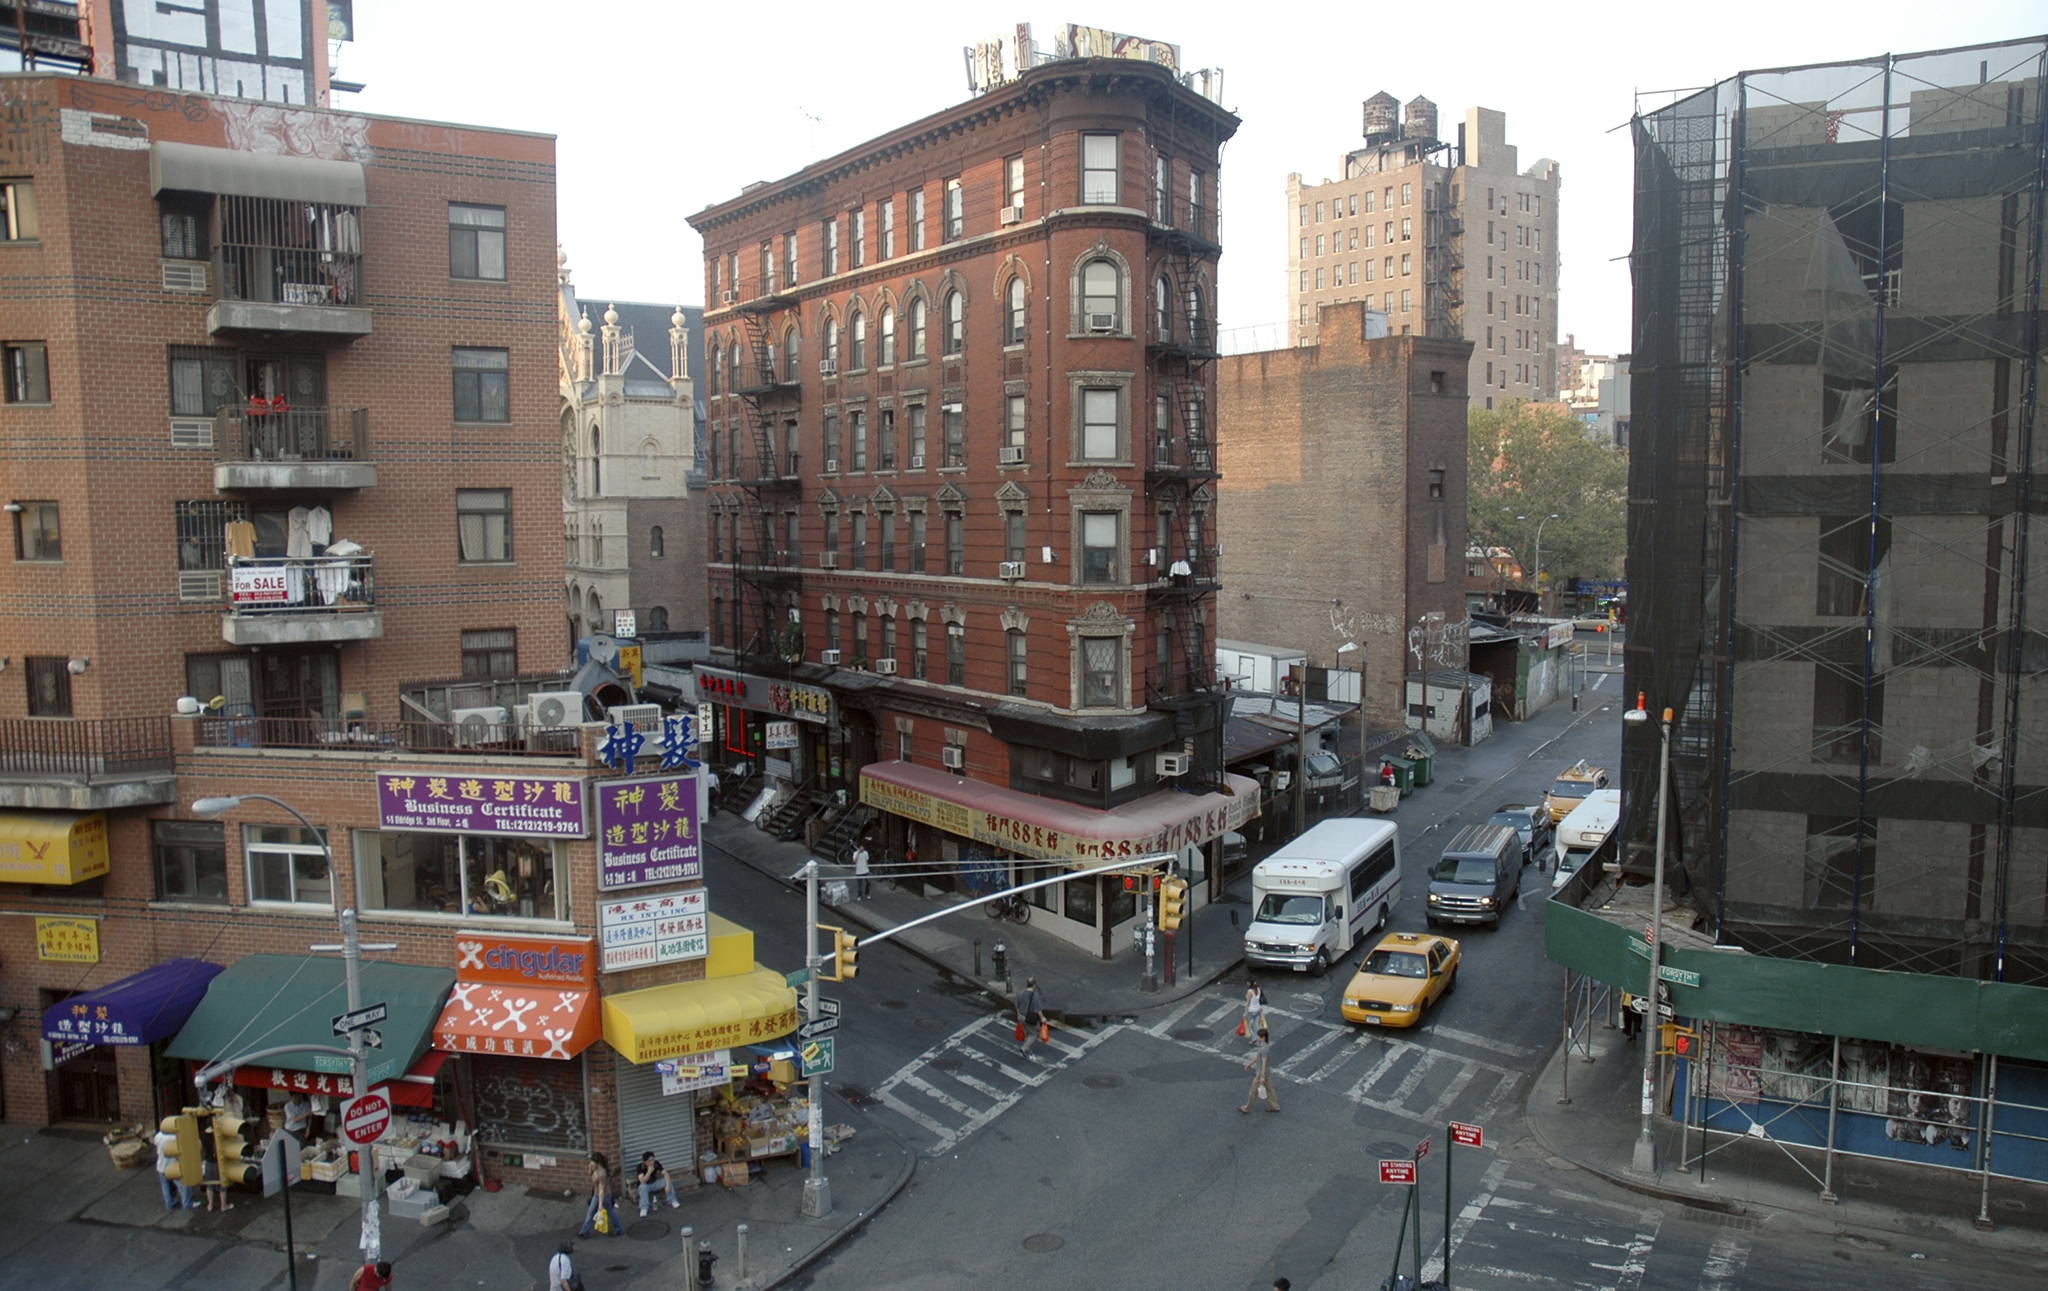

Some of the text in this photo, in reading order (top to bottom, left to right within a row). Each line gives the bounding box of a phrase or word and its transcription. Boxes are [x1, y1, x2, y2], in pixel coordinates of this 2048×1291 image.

[235, 577, 285, 590] FOR SALE
[700, 704, 712, 733] 味中王
[404, 799, 563, 818] Business Certificate
[426, 816, 436, 826] 2nd
[496, 819, 579, 833] TEL:(212)219-9761
[606, 817, 693, 847] 造型沙龍
[604, 845, 697, 867] Business Certificate
[644, 862, 698, 881] TEL:(212)219-9761
[641, 910, 667, 919] INT'L
[670, 907, 689, 915] INC.
[38, 920, 94, 934] JOB EMPLOYMENT AGENCY
[485, 945, 586, 977] cingular
[538, 973, 586, 983] Authorized Retailer
[1661, 966, 1692, 981] FORSYTH
[823, 1003, 836, 1012] WAY
[1634, 1000, 1649, 1009] ONE
[339, 1009, 381, 1030] ONE WAY
[803, 1019, 835, 1036] ONE WAY
[466, 1036, 534, 1055] 成功電訊
[315, 1059, 344, 1068] FORSYTH
[271, 1070, 353, 1095] 歡迎光臨
[350, 1100, 382, 1119] DO NOT
[354, 1122, 383, 1139] ENTER
[1455, 1130, 1477, 1139] ANYTIME
[1460, 1124, 1480, 1133] STANDING
